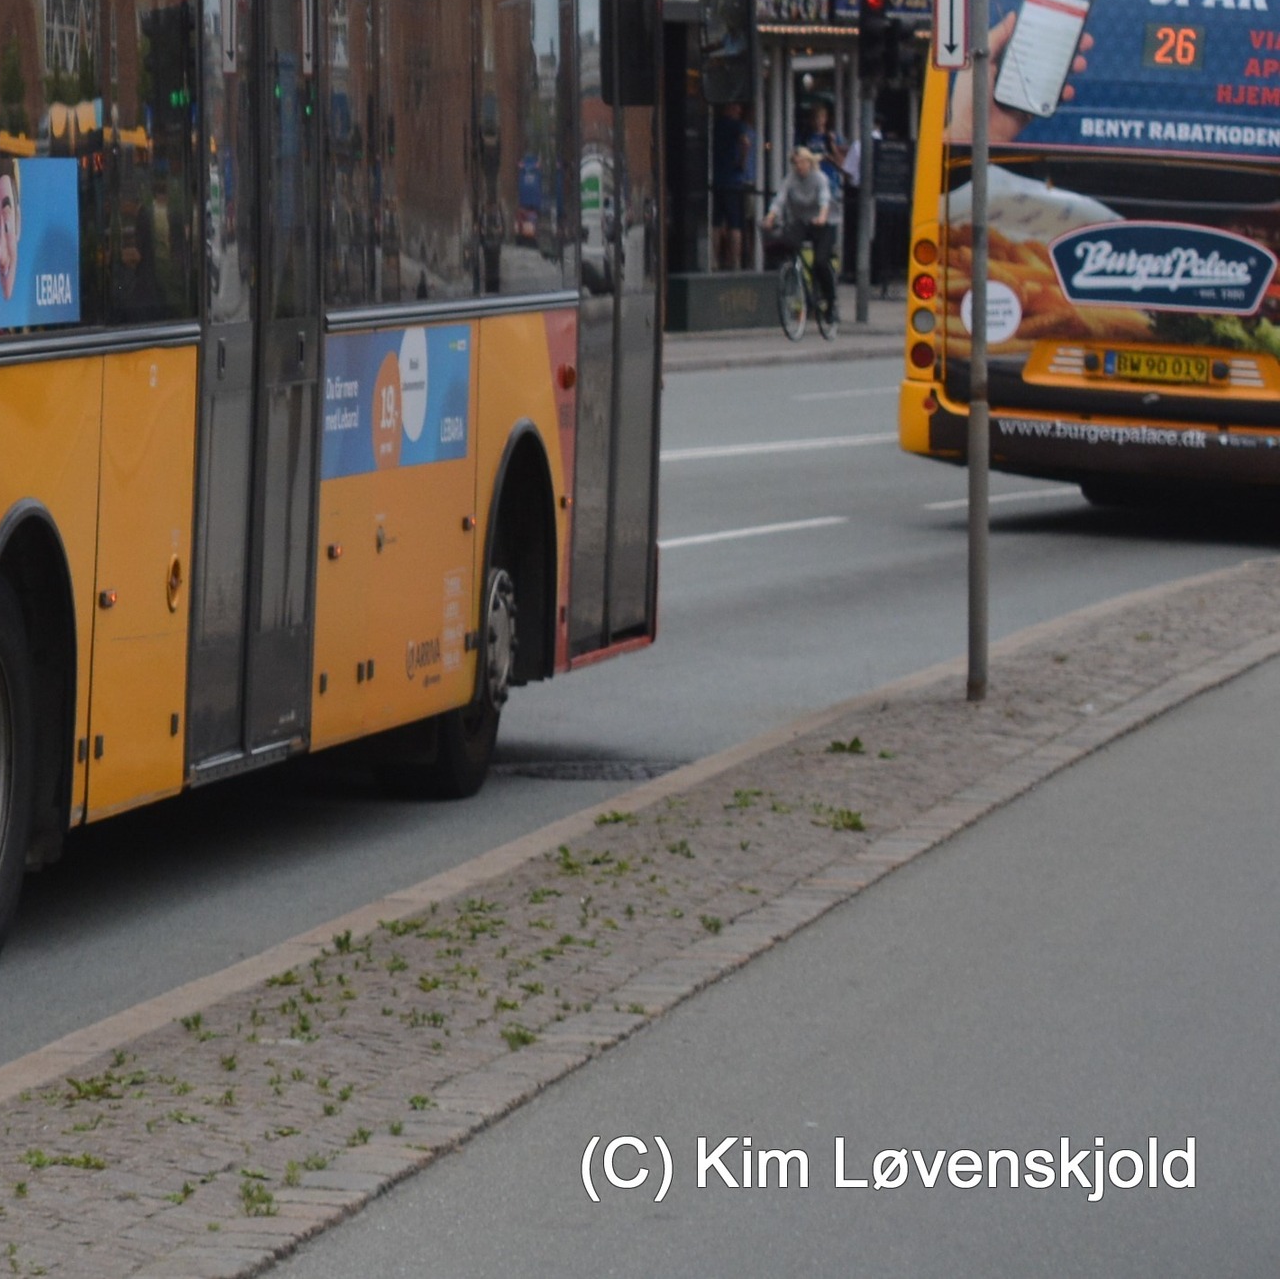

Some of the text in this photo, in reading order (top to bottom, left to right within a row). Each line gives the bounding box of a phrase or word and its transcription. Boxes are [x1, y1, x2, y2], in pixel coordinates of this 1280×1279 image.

[1154, 26, 1196, 65] 26
[1080, 117, 1144, 140] BENYT
[36, 274, 72, 305] LEBARA
[998, 419, 1206, 449] www.burgerpalace.dk
